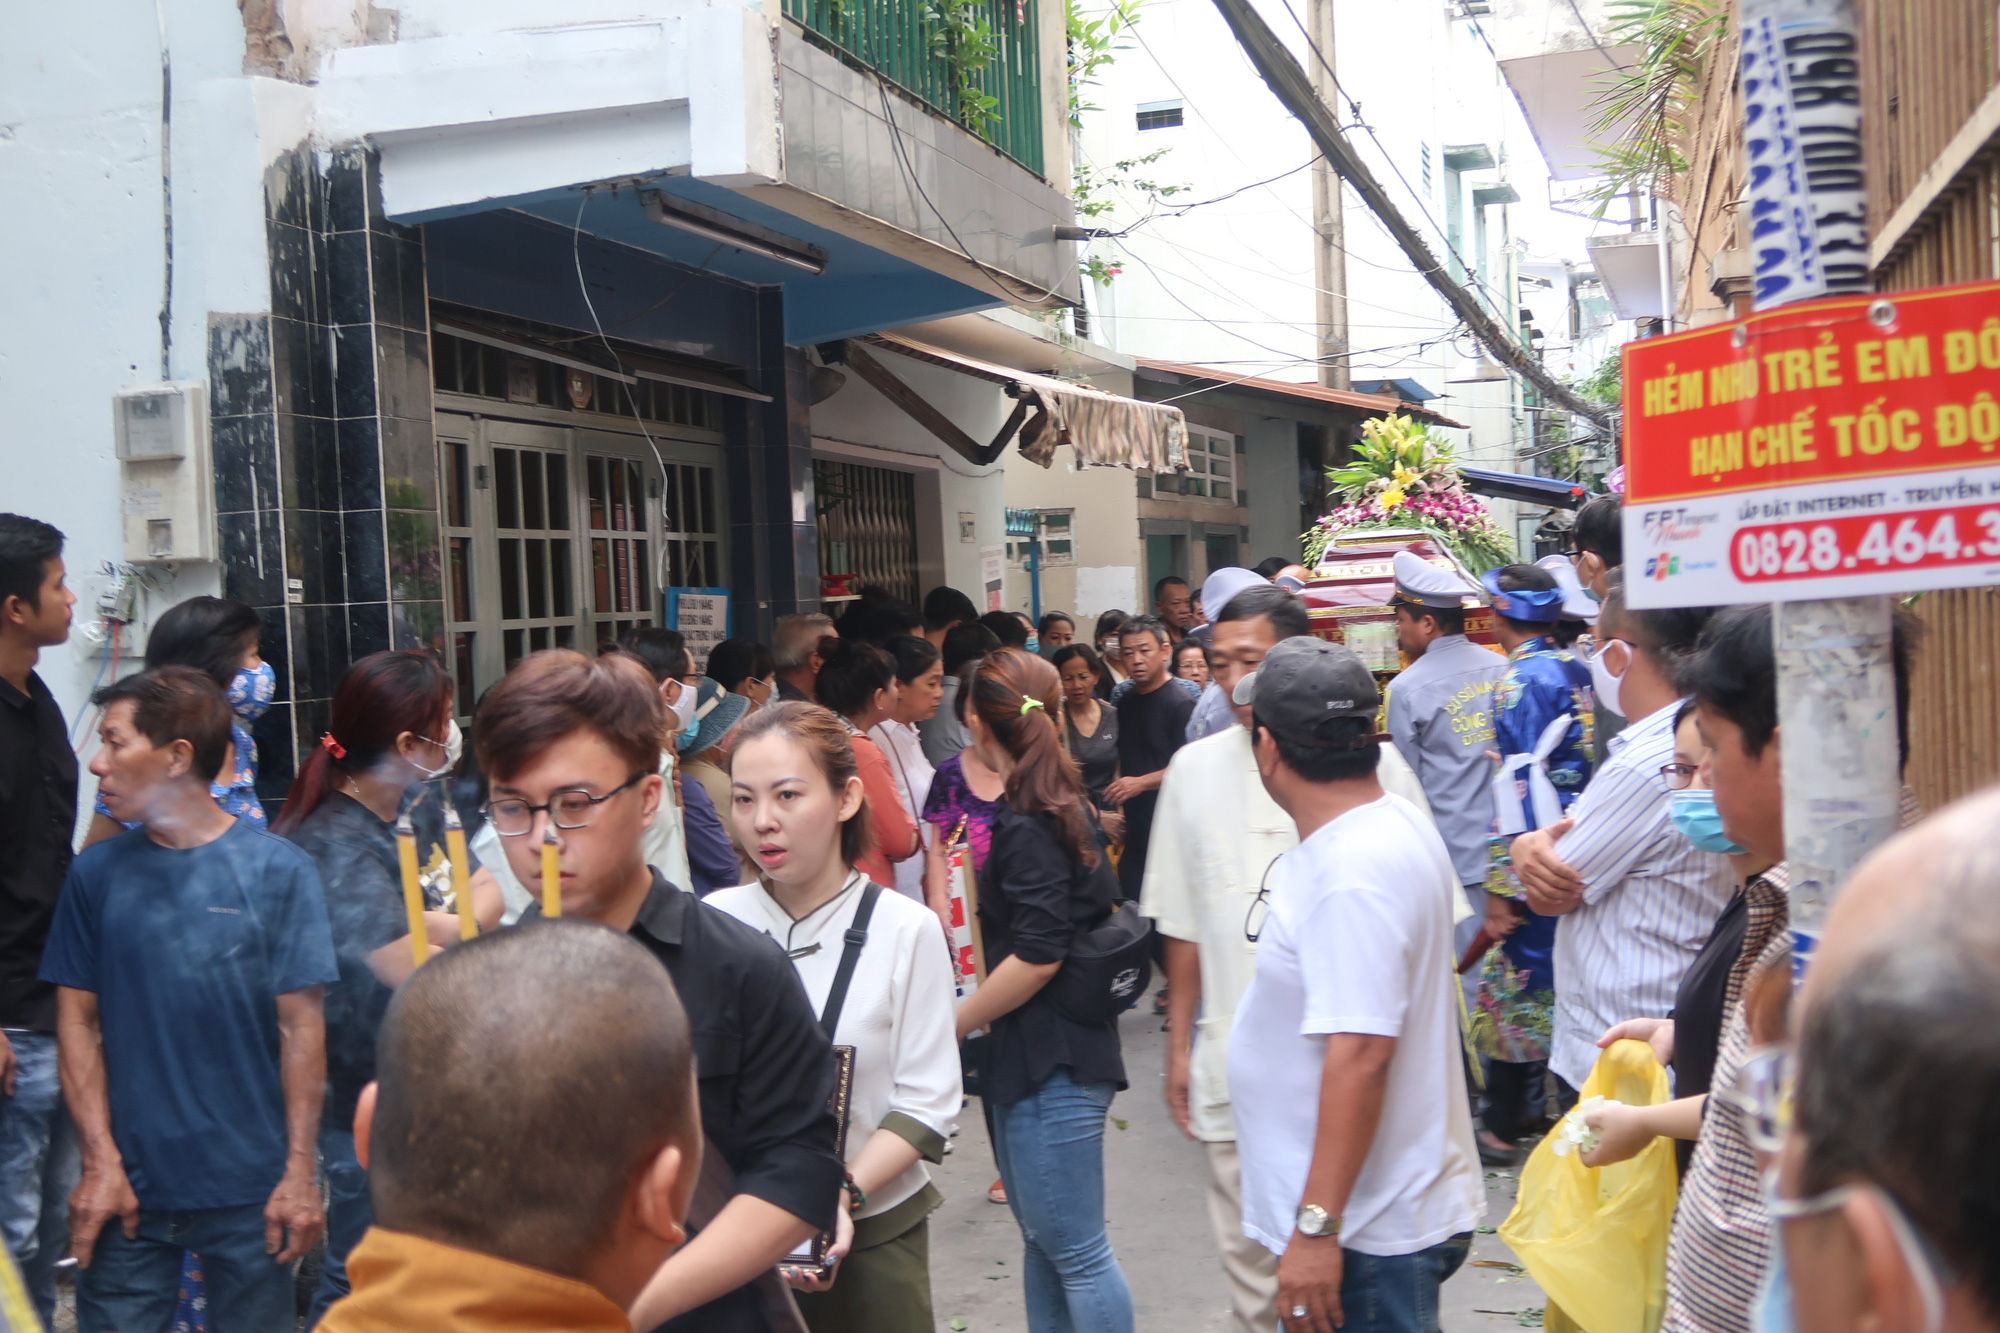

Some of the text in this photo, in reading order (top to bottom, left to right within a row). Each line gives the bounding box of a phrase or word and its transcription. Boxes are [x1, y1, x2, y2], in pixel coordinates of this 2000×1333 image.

[1643, 362, 1704, 418] HẺM
[1710, 345, 1760, 406] NHỎ
[1763, 330, 1843, 394] TRẺ
[1856, 335, 1931, 383] EM
[1690, 391, 2000, 483] HẠN CHẾ TỐC ĐỘ
[1643, 508, 1687, 529] FPT
[1797, 492, 1886, 514] INTERNET
[1905, 476, 1983, 504] TRUYỀN
[1738, 509, 2000, 577] 0828.464.3
[1326, 700, 1354, 710] POLO
